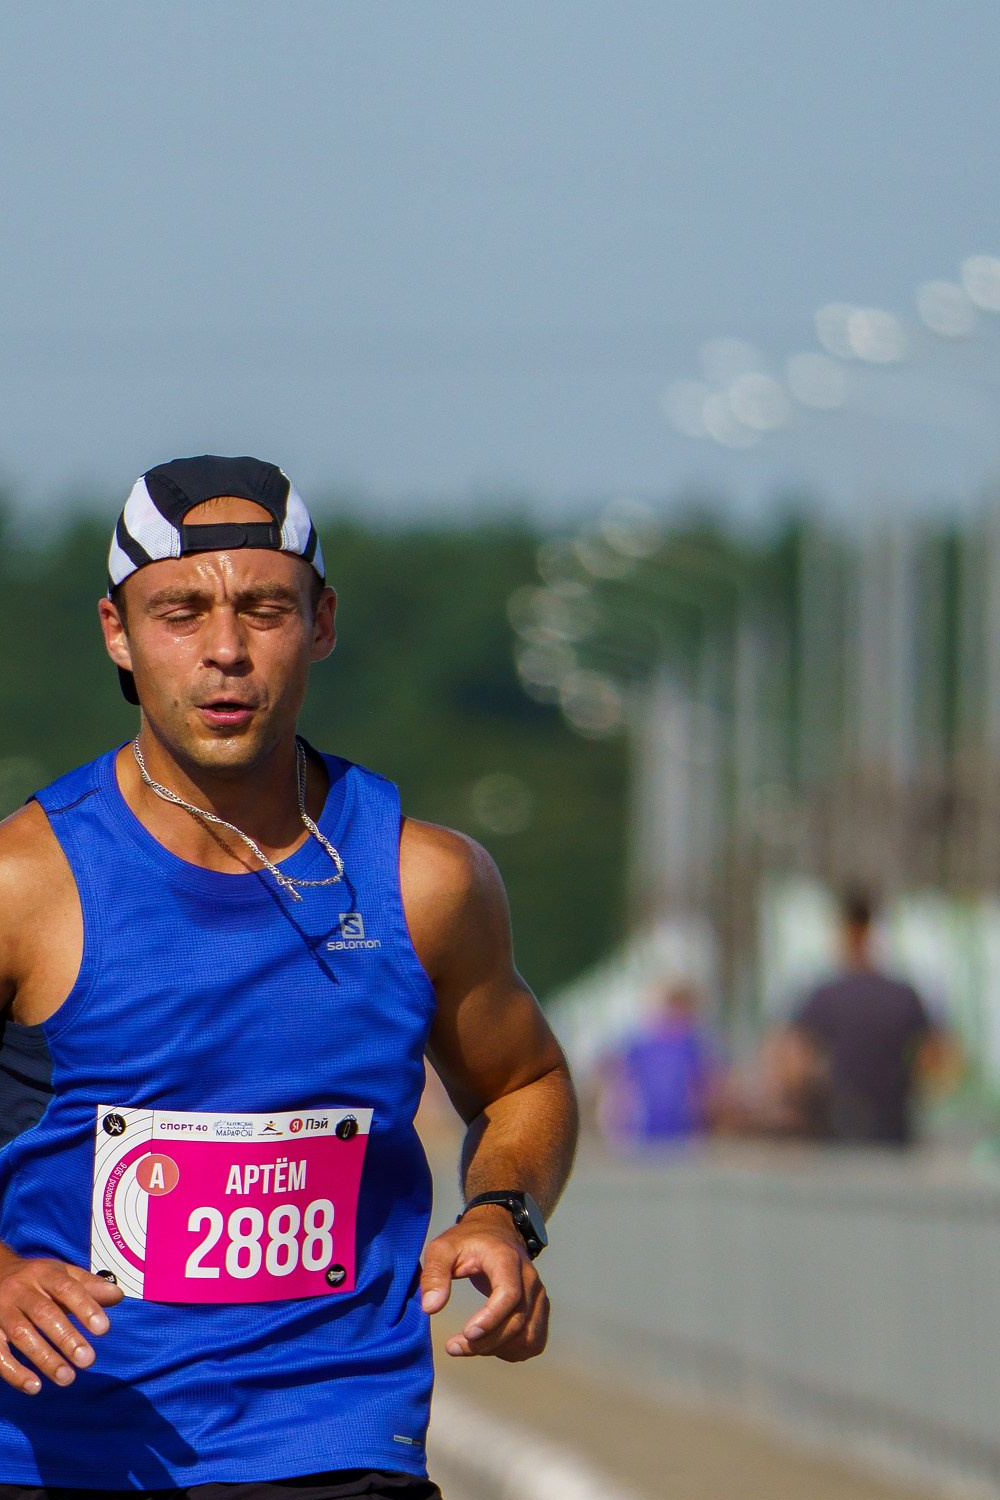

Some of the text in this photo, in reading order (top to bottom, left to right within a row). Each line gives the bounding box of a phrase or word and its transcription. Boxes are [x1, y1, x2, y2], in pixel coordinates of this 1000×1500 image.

[160, 1123, 194, 1131] СПОРТ
[305, 1118, 328, 1130] Пэй
[215, 1129, 253, 1137] МАРАФОН
[225, 1157, 307, 1195] АРТЁМ
[105, 1178, 117, 1207] розовый
[105, 1209, 115, 1226] забег
[111, 1231, 121, 1240] 10
[185, 1199, 335, 1279] 2888
